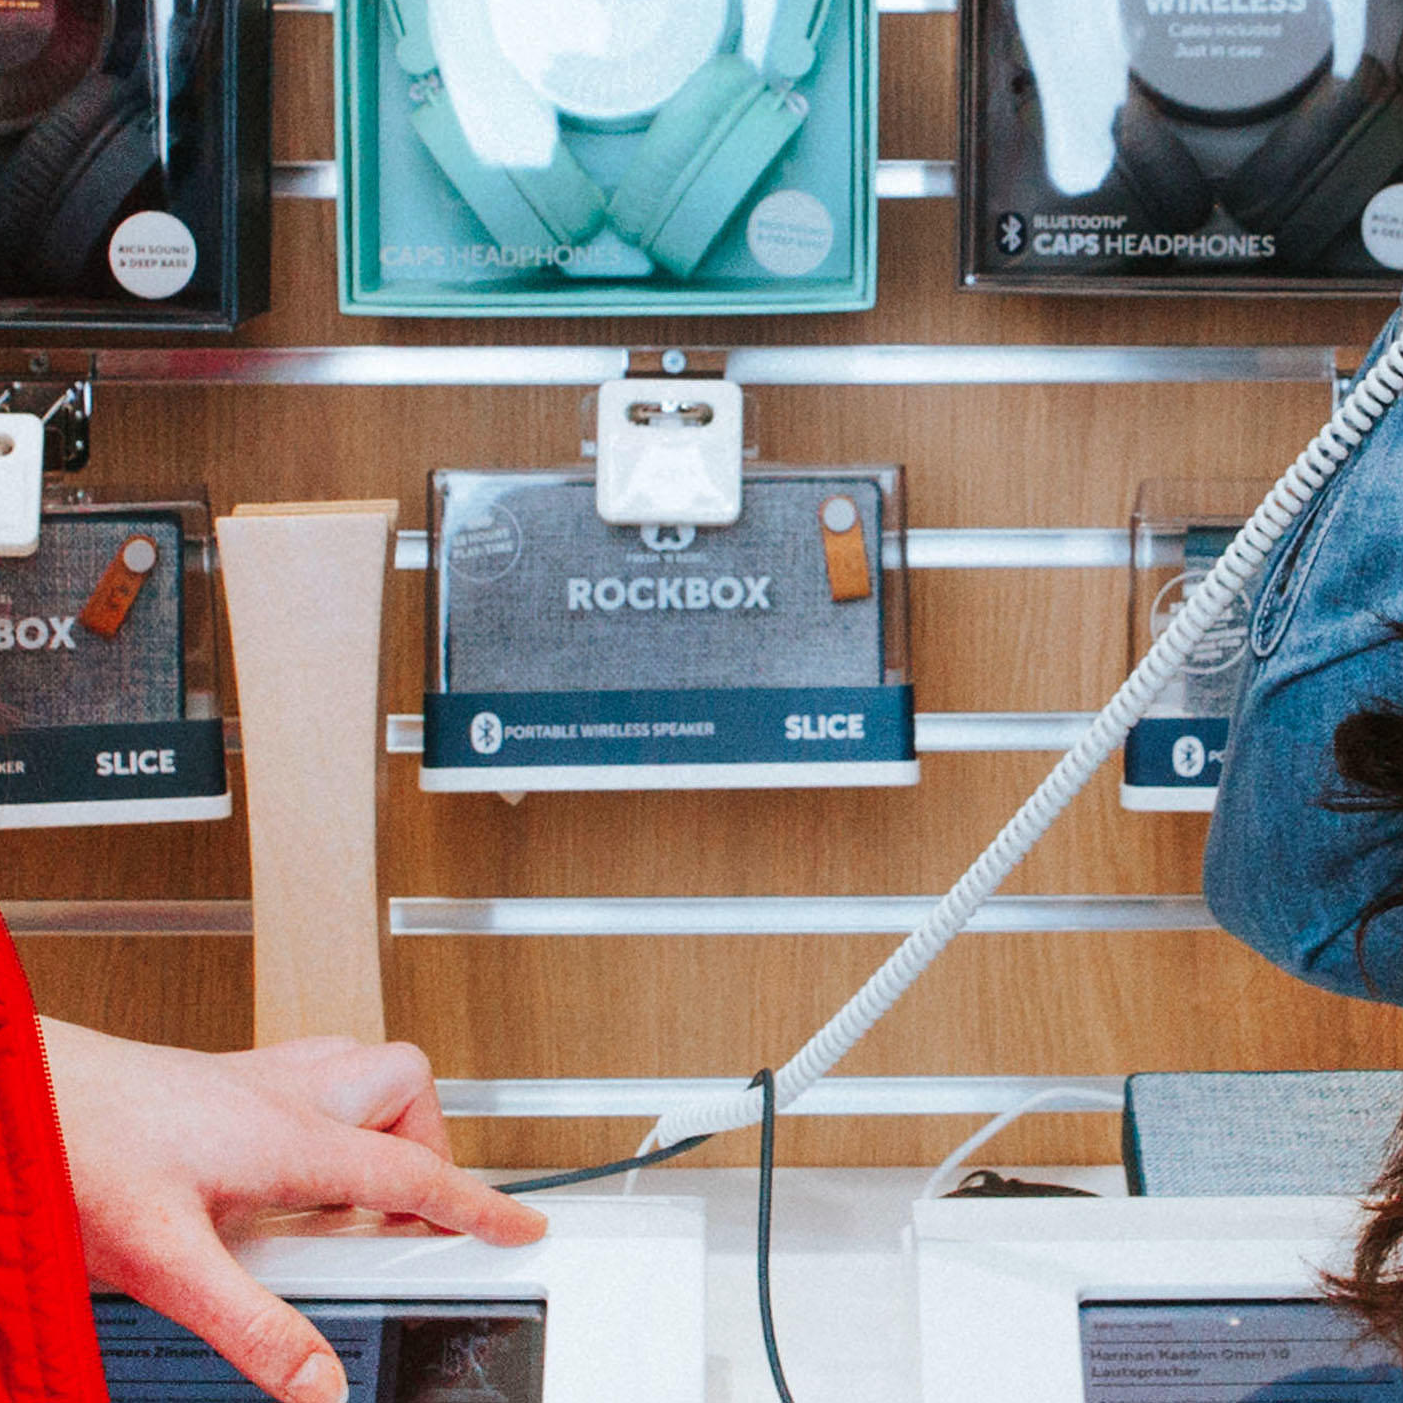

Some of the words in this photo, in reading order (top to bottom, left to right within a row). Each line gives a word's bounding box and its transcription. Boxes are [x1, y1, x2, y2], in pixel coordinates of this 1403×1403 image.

[118, 245, 146, 255] RICH
[147, 245, 189, 255] SOUND
[1032, 233, 1100, 256] CAPS
[1104, 234, 1276, 257] HEADPHONES
[129, 258, 159, 269] DEEP
[160, 258, 188, 269] BASS
[379, 244, 445, 267] CAPS
[451, 244, 622, 268] HEADPHONES
[567, 576, 771, 612] ROCKBOX
[504, 725, 578, 741] PORTABLE
[580, 723, 650, 739] WIRELESS
[651, 722, 715, 737] SPEAKER
[785, 713, 866, 741] SLICE
[95, 749, 176, 776] SLICE
[1090, 1349, 1155, 1362] Harman
[1158, 1348, 1218, 1361] Kardon
[1090, 1367, 1201, 1380] Lautsprecher
